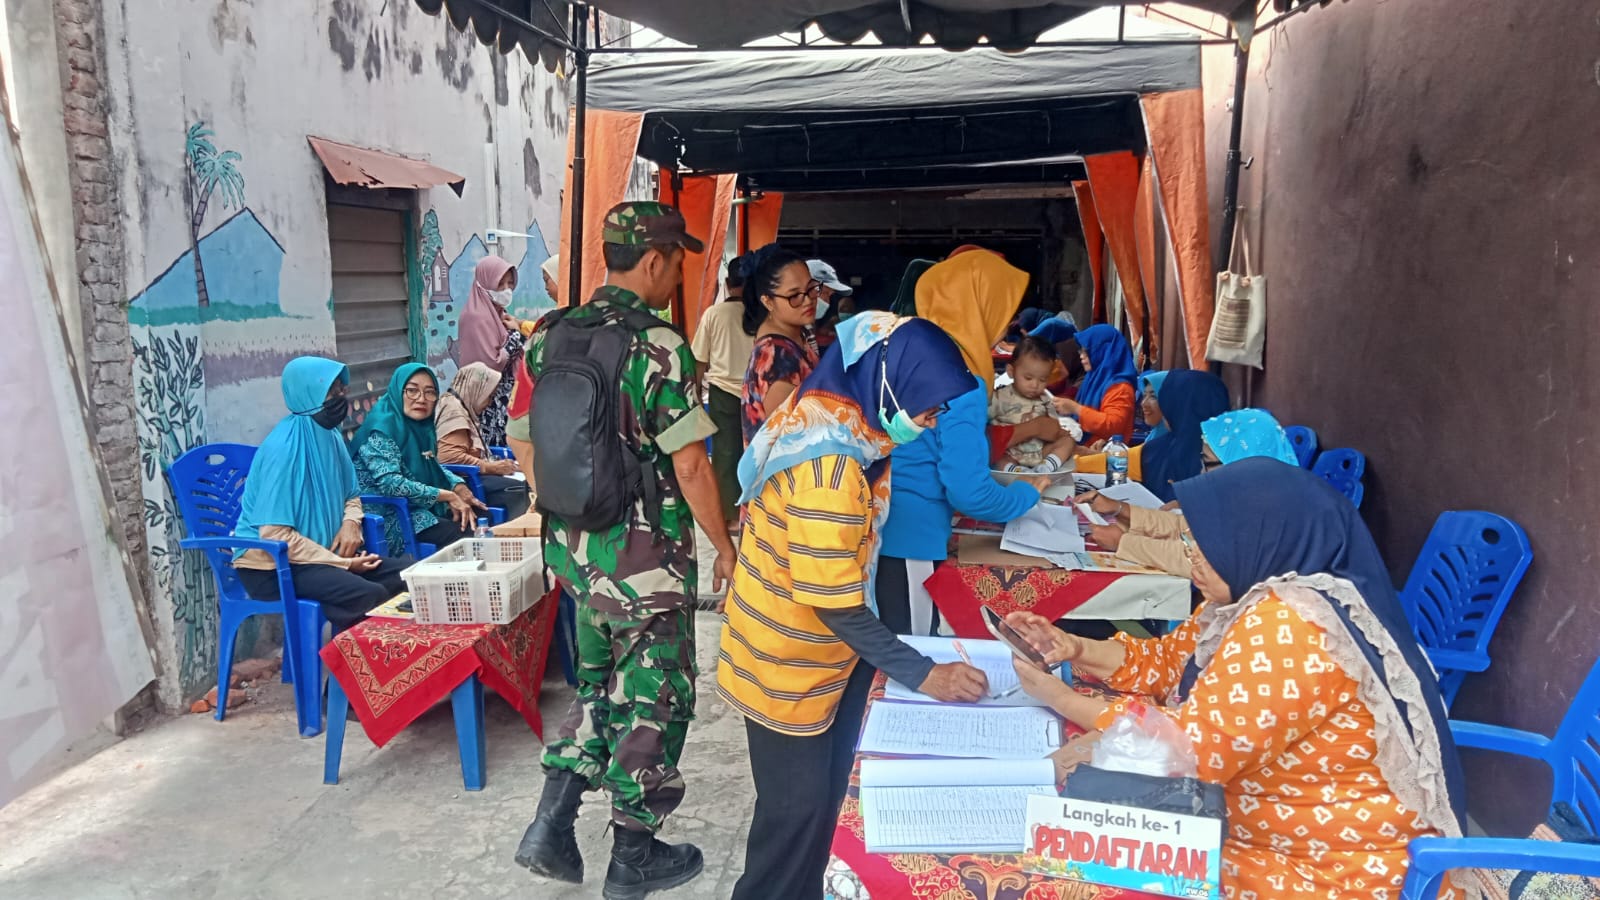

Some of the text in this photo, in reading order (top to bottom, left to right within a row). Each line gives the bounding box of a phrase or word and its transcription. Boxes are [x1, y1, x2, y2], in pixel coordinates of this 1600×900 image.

[1063, 803, 1182, 835] Langkah ke- 1
[1035, 825, 1208, 881] PENDAFTARAN
